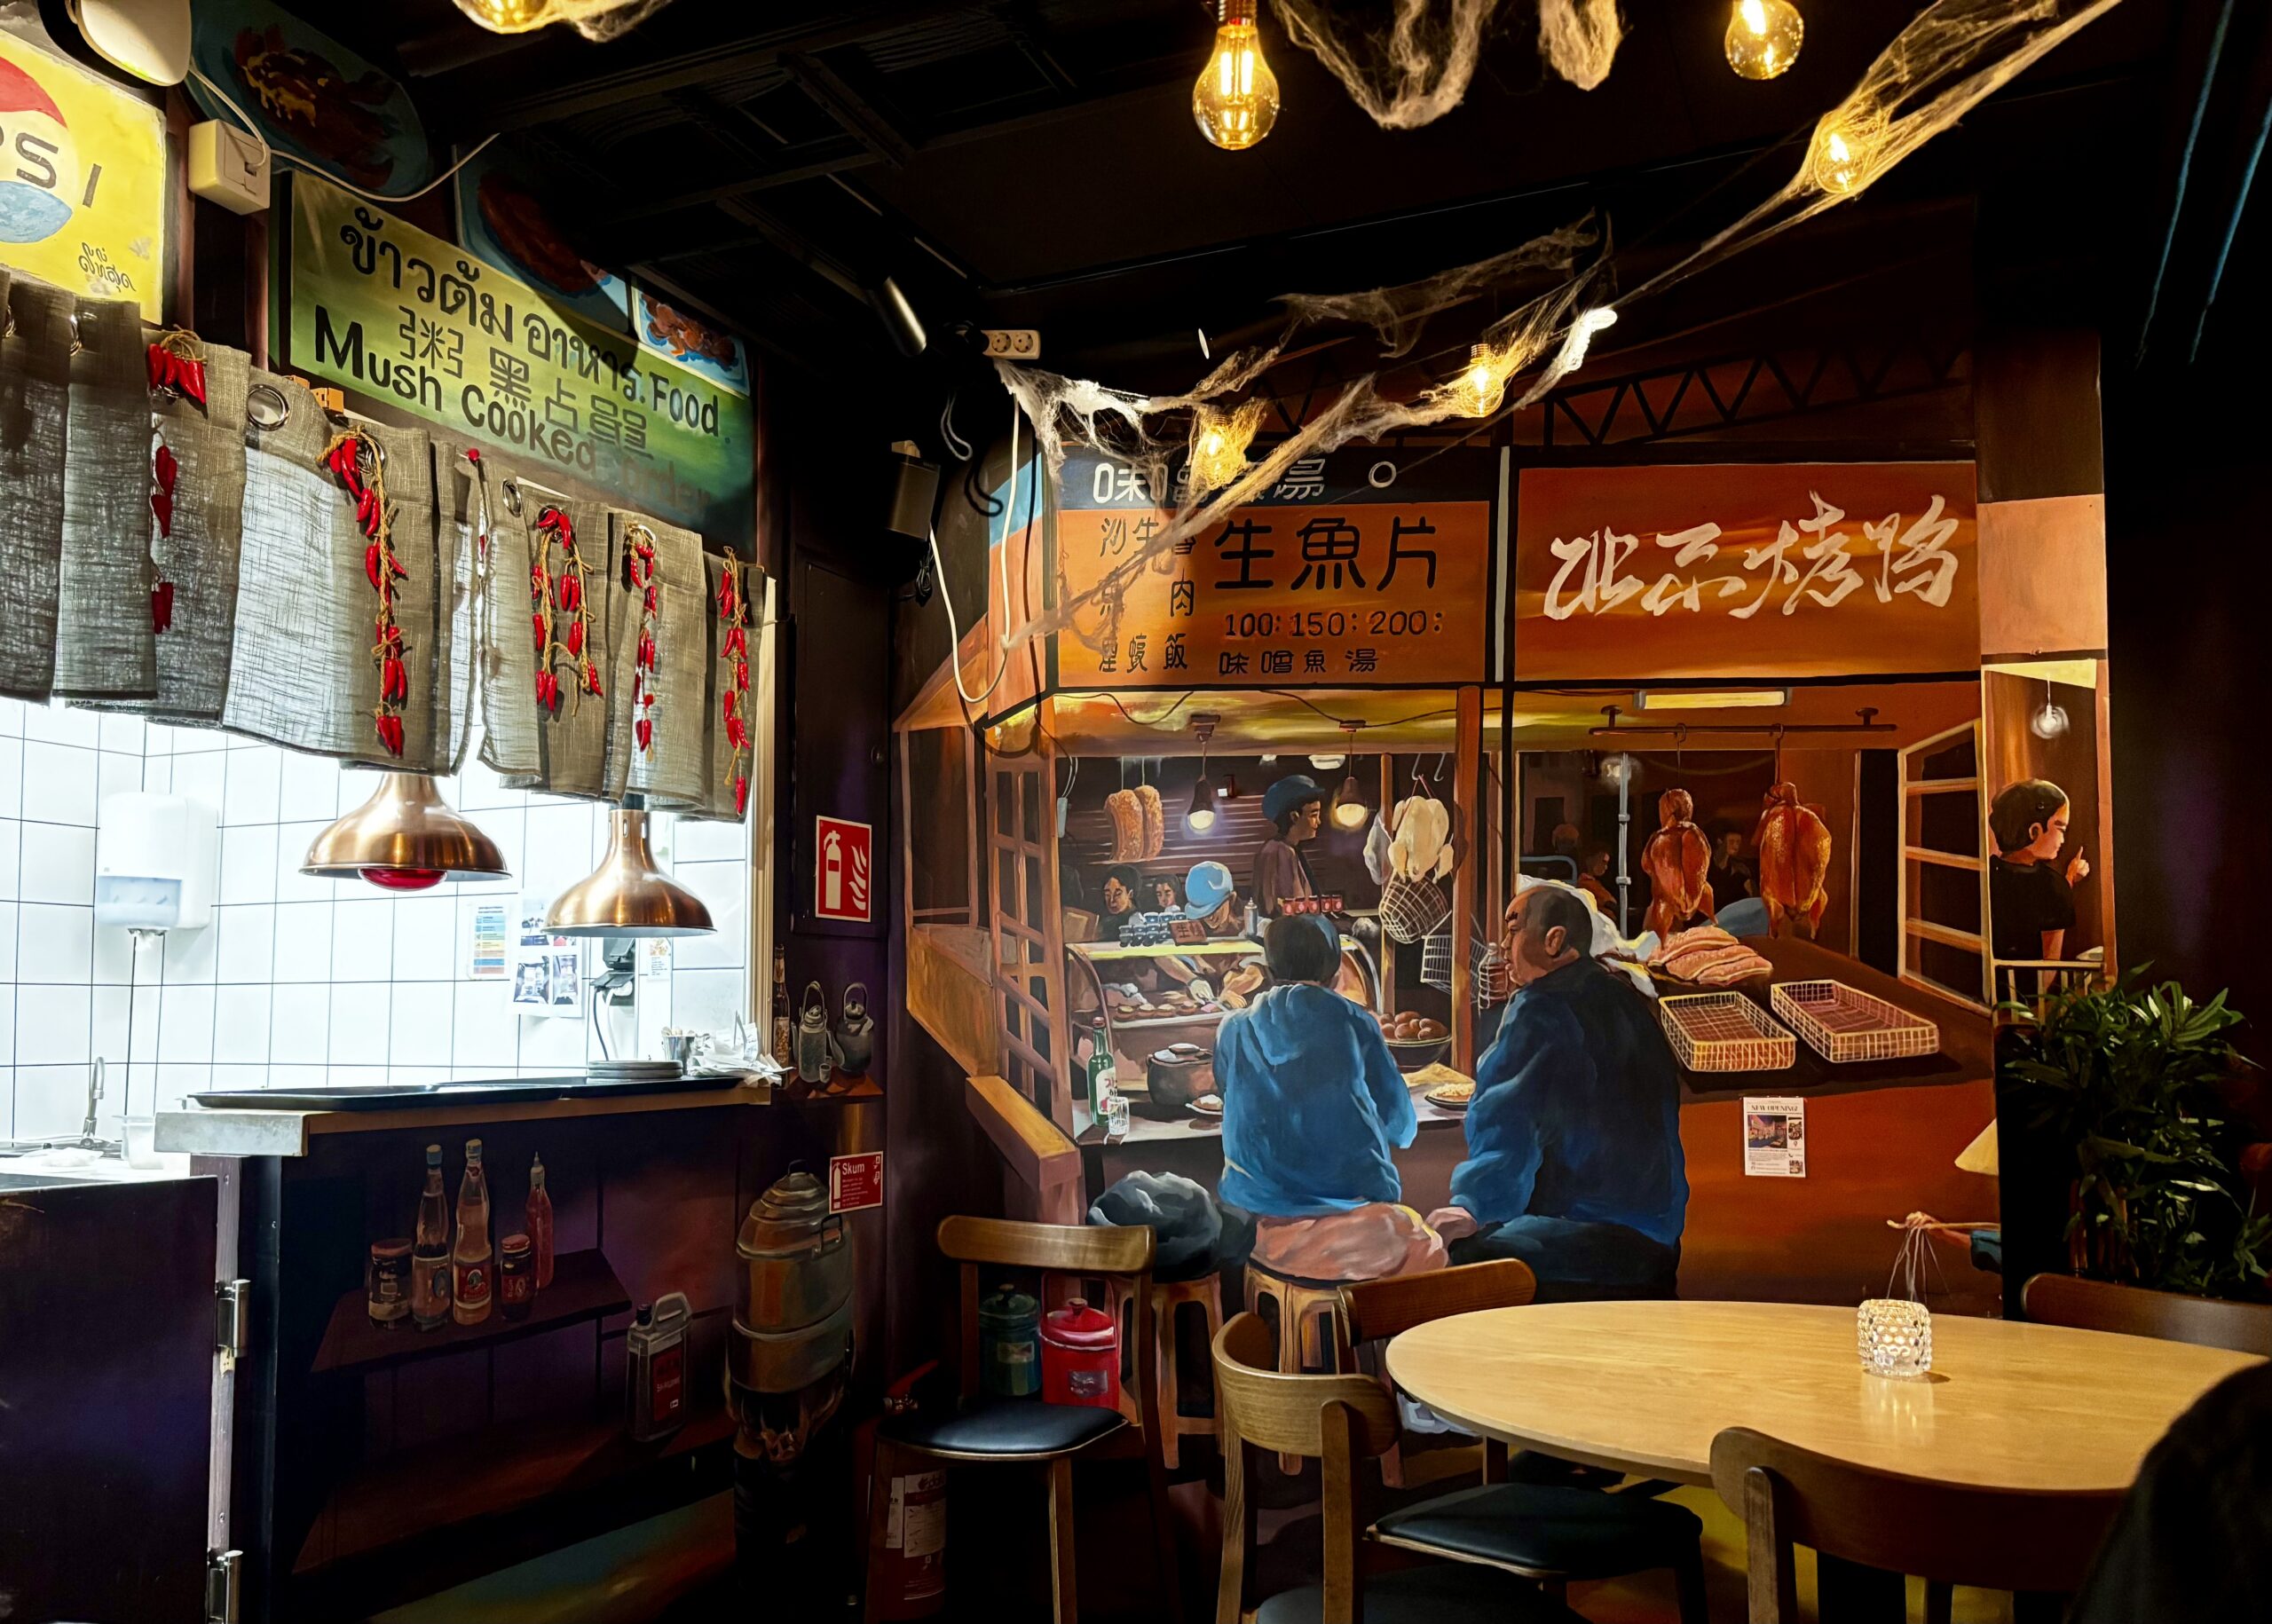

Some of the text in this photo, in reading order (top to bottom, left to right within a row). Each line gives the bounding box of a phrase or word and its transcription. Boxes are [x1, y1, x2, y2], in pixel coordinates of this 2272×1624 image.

[0, 125, 102, 209] SI
[315, 305, 443, 412] Mush
[649, 371, 719, 438] Food
[1213, 516, 1437, 592] 生魚片
[842, 1162, 865, 1176] Skum
